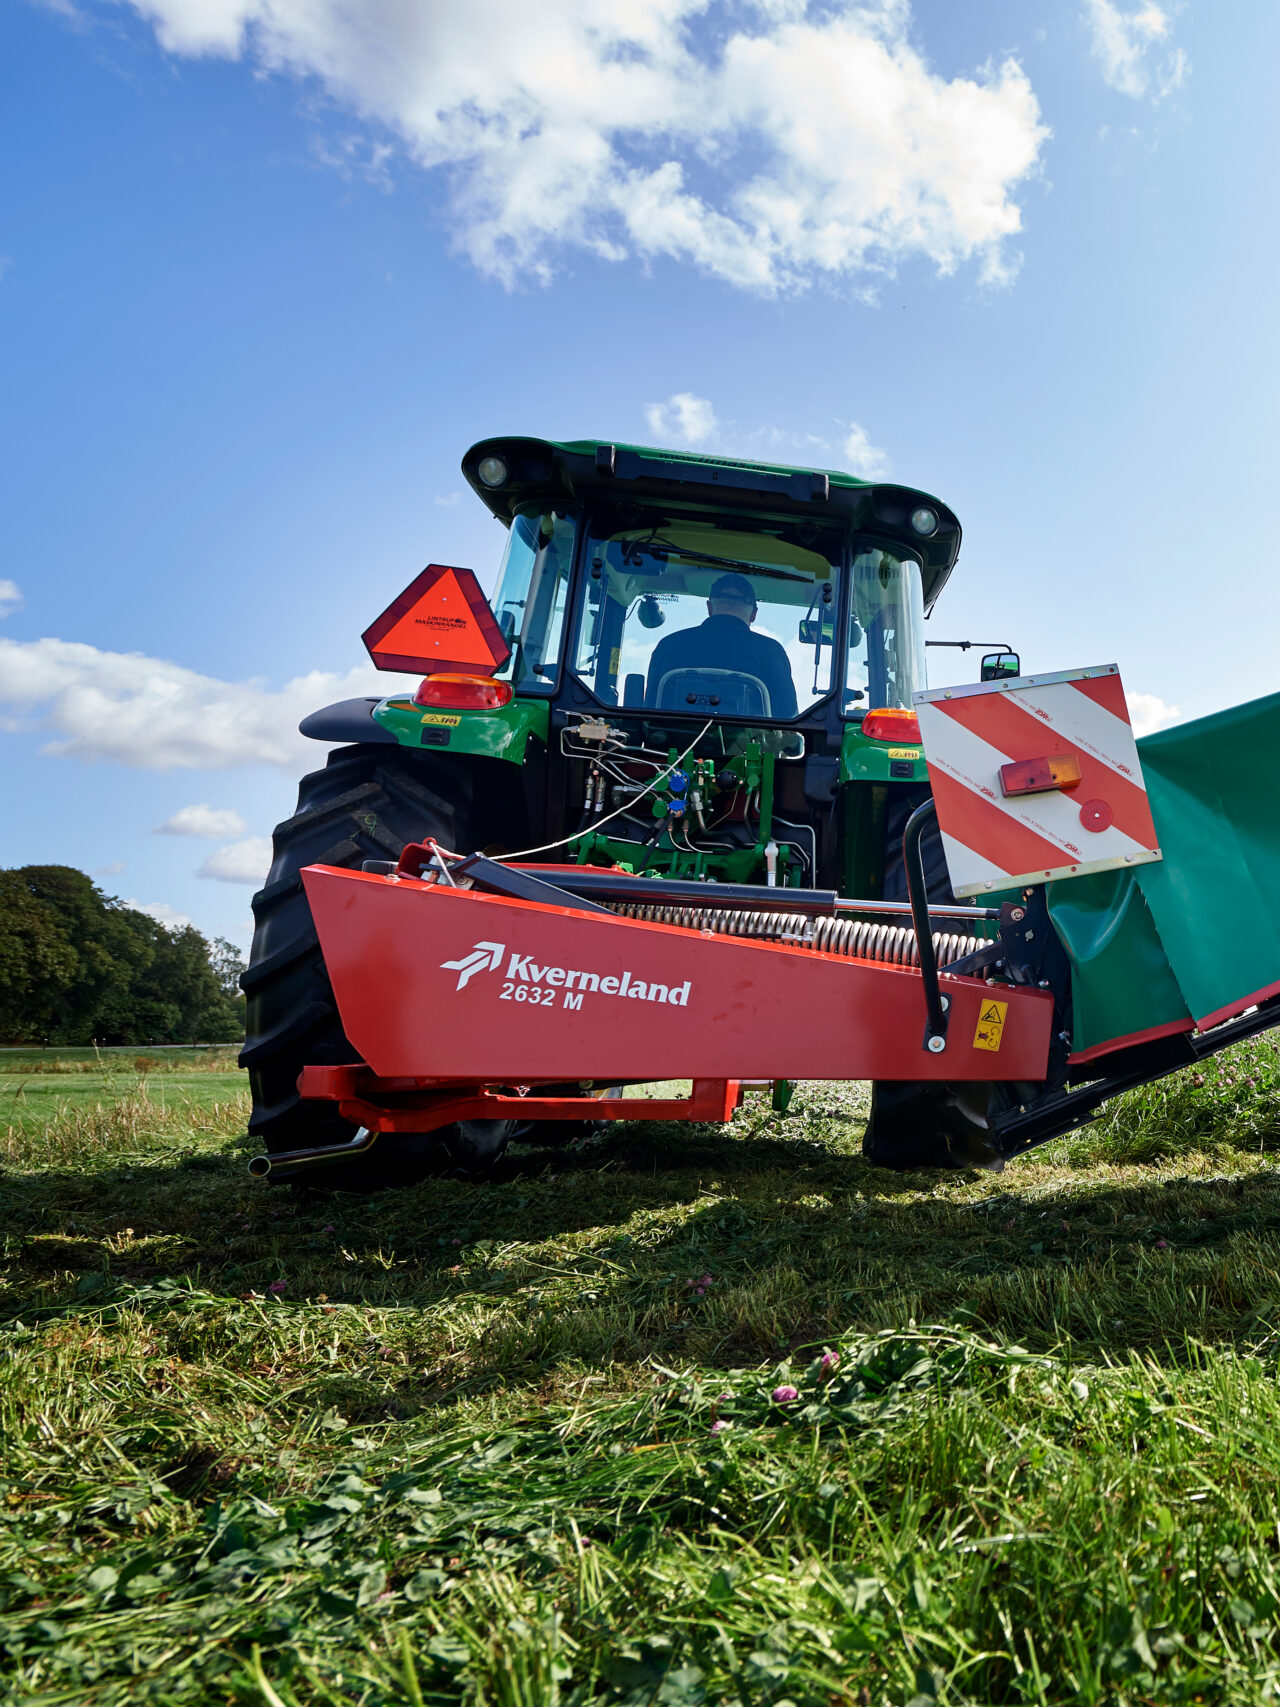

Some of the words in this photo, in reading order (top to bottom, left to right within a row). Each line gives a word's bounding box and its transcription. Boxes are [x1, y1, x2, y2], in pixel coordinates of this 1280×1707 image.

[415, 619, 467, 629] MASKINHANDEL
[505, 953, 692, 1006] Kverneland
[499, 982, 556, 1006] 2632
[563, 992, 584, 1010] M
